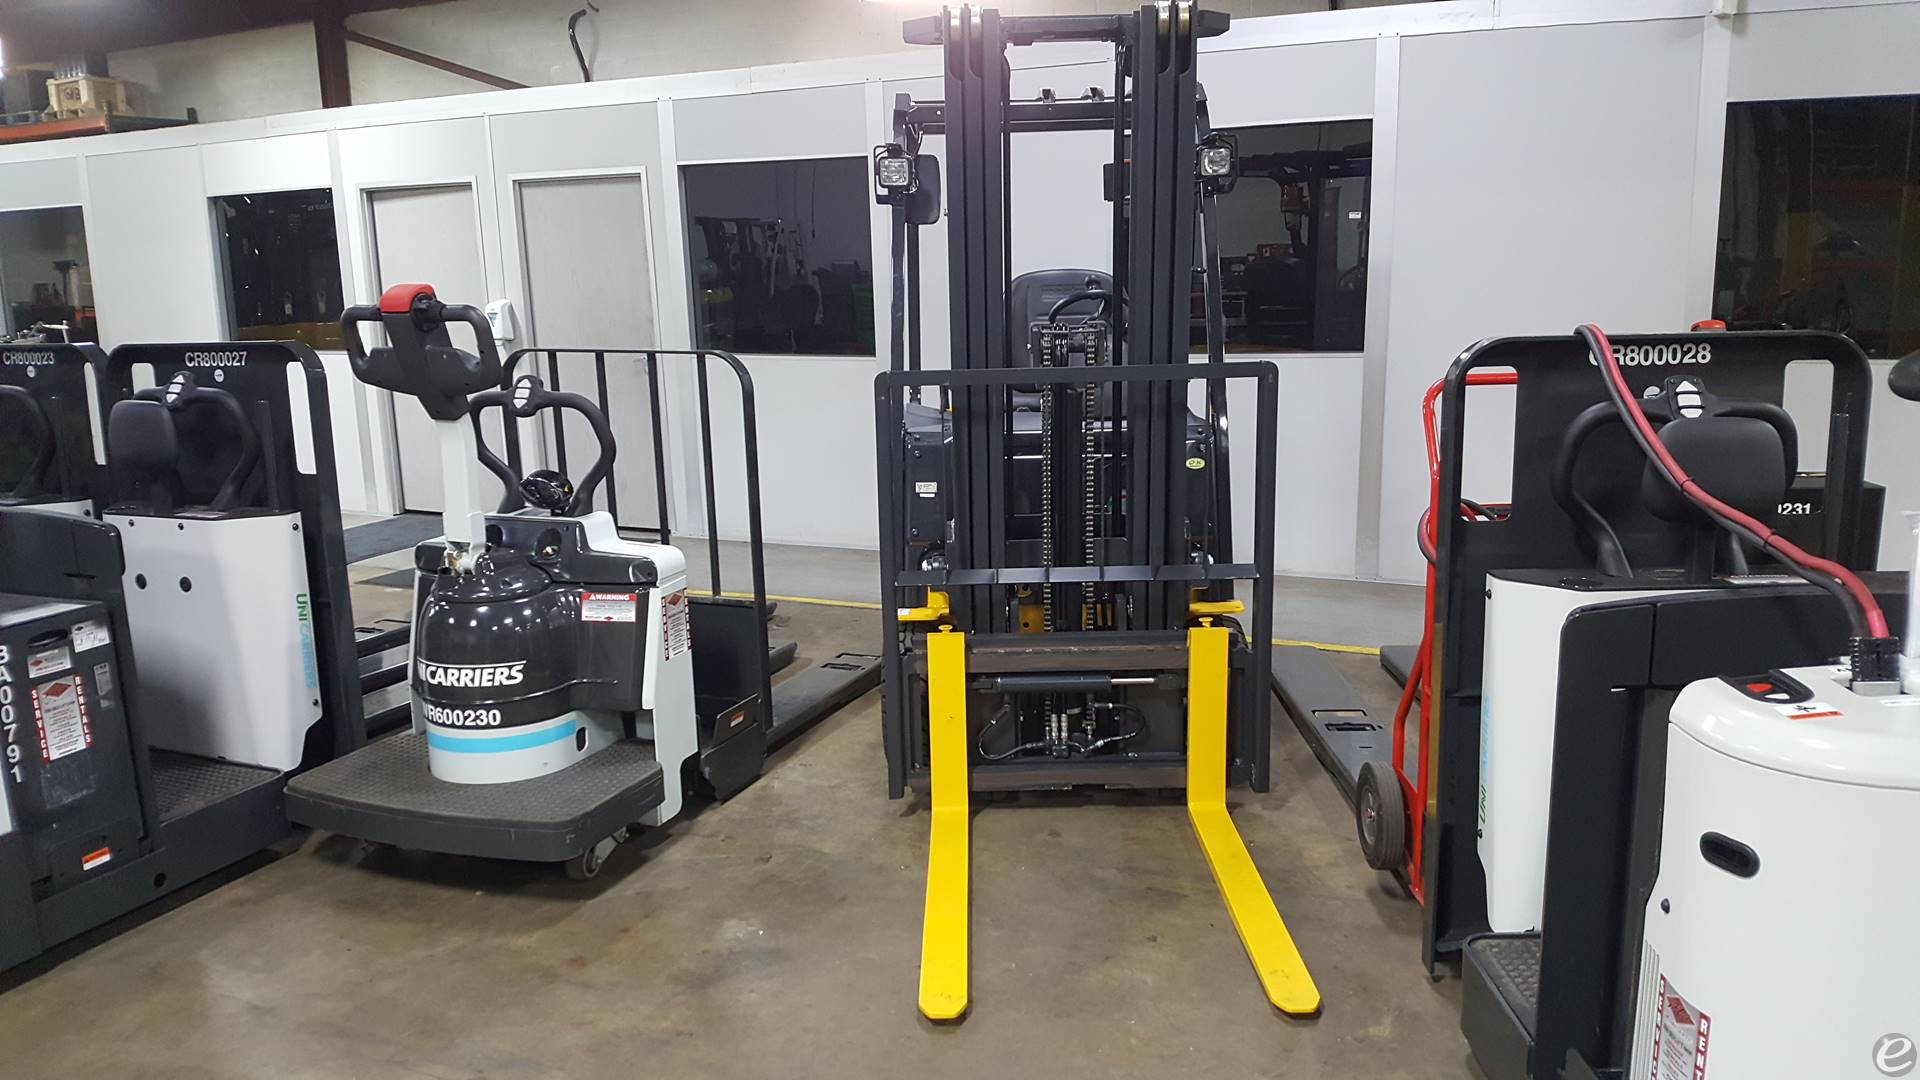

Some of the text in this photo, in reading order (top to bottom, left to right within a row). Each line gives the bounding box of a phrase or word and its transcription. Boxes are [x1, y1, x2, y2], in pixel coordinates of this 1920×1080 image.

[184, 351, 248, 367] CR800027
[31, 689, 48, 758] SERVICE
[74, 676, 91, 742] RENTALS
